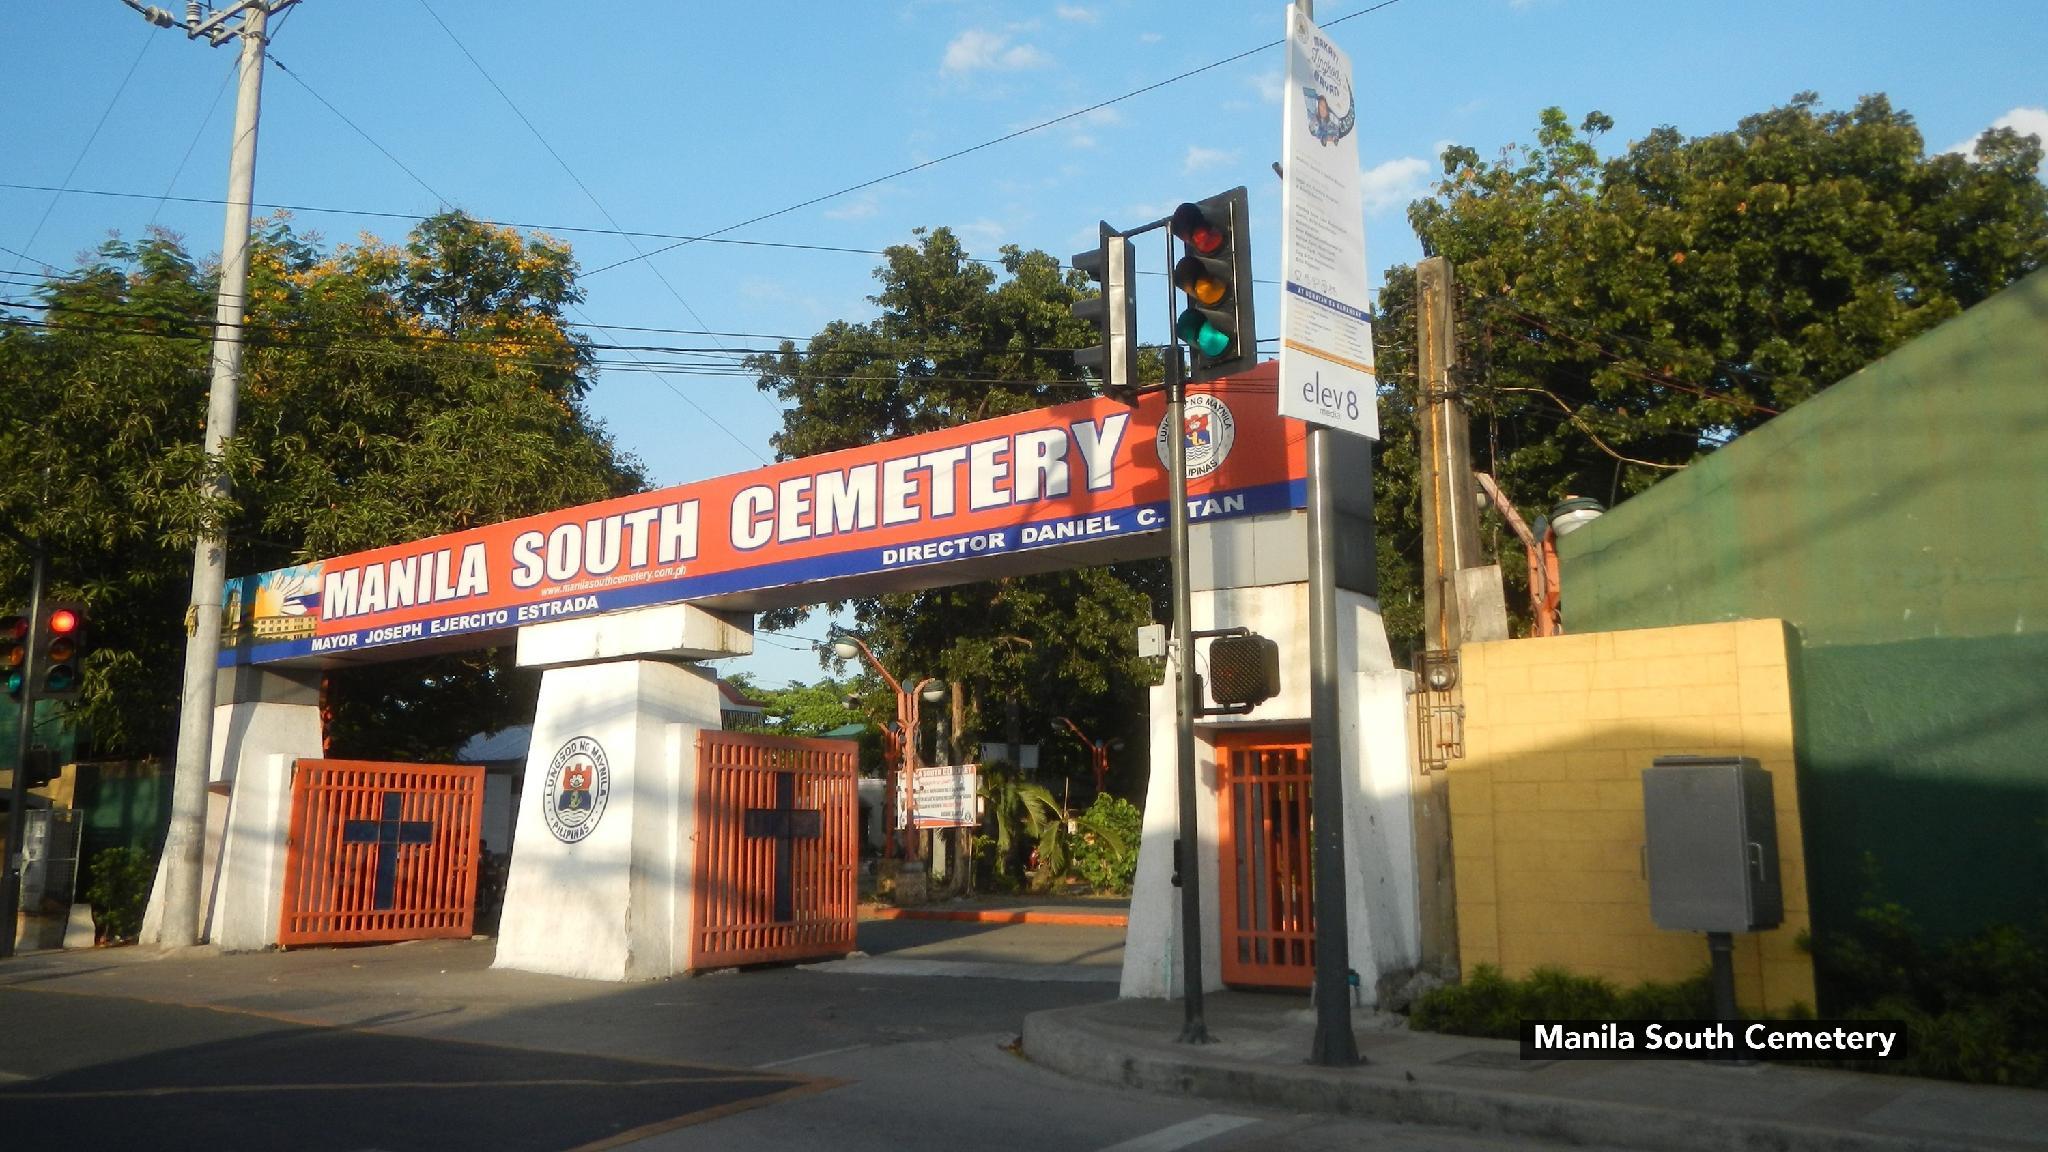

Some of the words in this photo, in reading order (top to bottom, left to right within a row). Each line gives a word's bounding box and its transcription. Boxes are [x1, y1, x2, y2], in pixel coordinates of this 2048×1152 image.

[1190, 397, 1203, 405] NG
[1205, 398, 1232, 430] MAYNILA
[1319, 408, 1341, 421] media
[322, 542, 489, 621] MANILA
[511, 498, 700, 589] SOUTH
[730, 412, 1131, 551] CEMETERY
[882, 532, 1006, 565] DIRECTOR
[1021, 515, 1120, 544] DANIEL
[1136, 508, 1164, 526] C.
[1187, 494, 1245, 518] TAN
[541, 565, 686, 596] www.manilasouthcemetery.com.ph
[311, 633, 357, 651] MAYOR
[365, 622, 422, 644] JOSEPH
[430, 609, 508, 634] EJERCITO
[517, 595, 599, 621] ESTRADA
[546, 743, 577, 797] LUNGSOD
[580, 741, 589, 751] NG
[590, 747, 607, 796] MAYNILA
[552, 823, 590, 840] PILIPINAS
